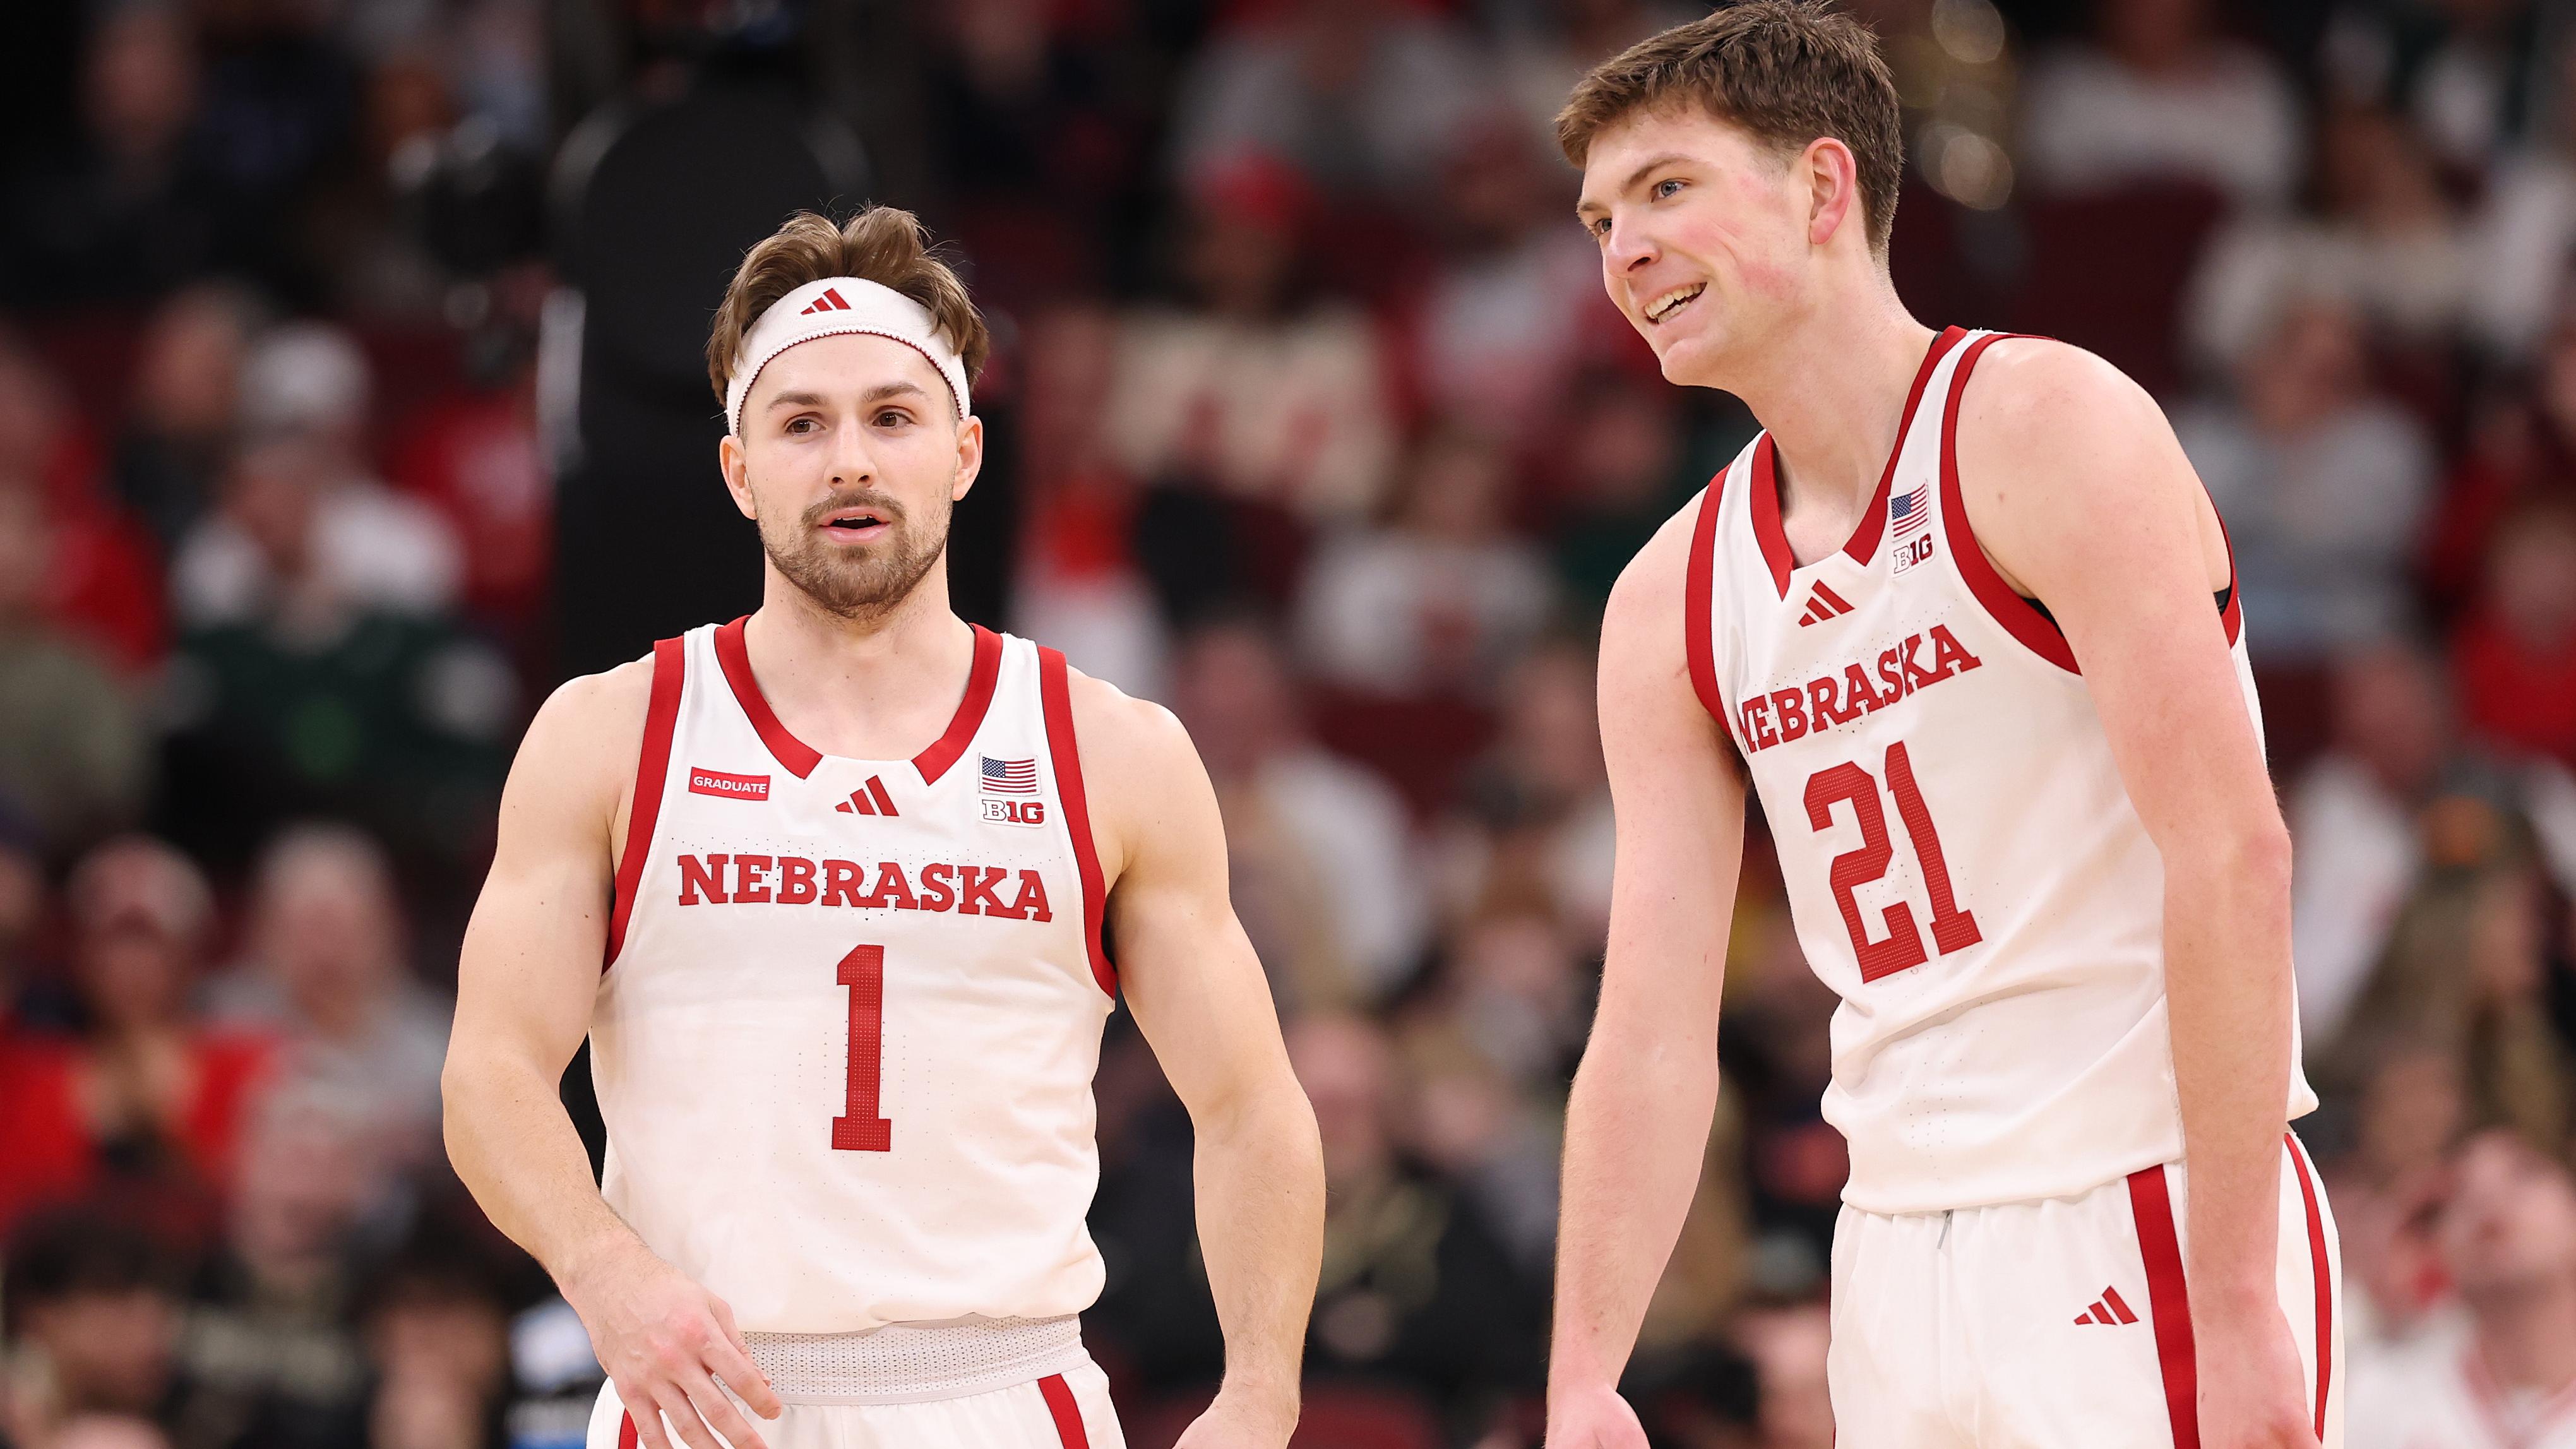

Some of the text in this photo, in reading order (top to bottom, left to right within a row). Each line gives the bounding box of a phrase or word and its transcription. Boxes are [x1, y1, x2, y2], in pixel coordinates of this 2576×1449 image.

[693, 776, 766, 794] GRADUATE
[677, 854, 1052, 922] NEBRASKA
[1803, 741, 1983, 984] 21
[832, 945, 891, 1152] 1
